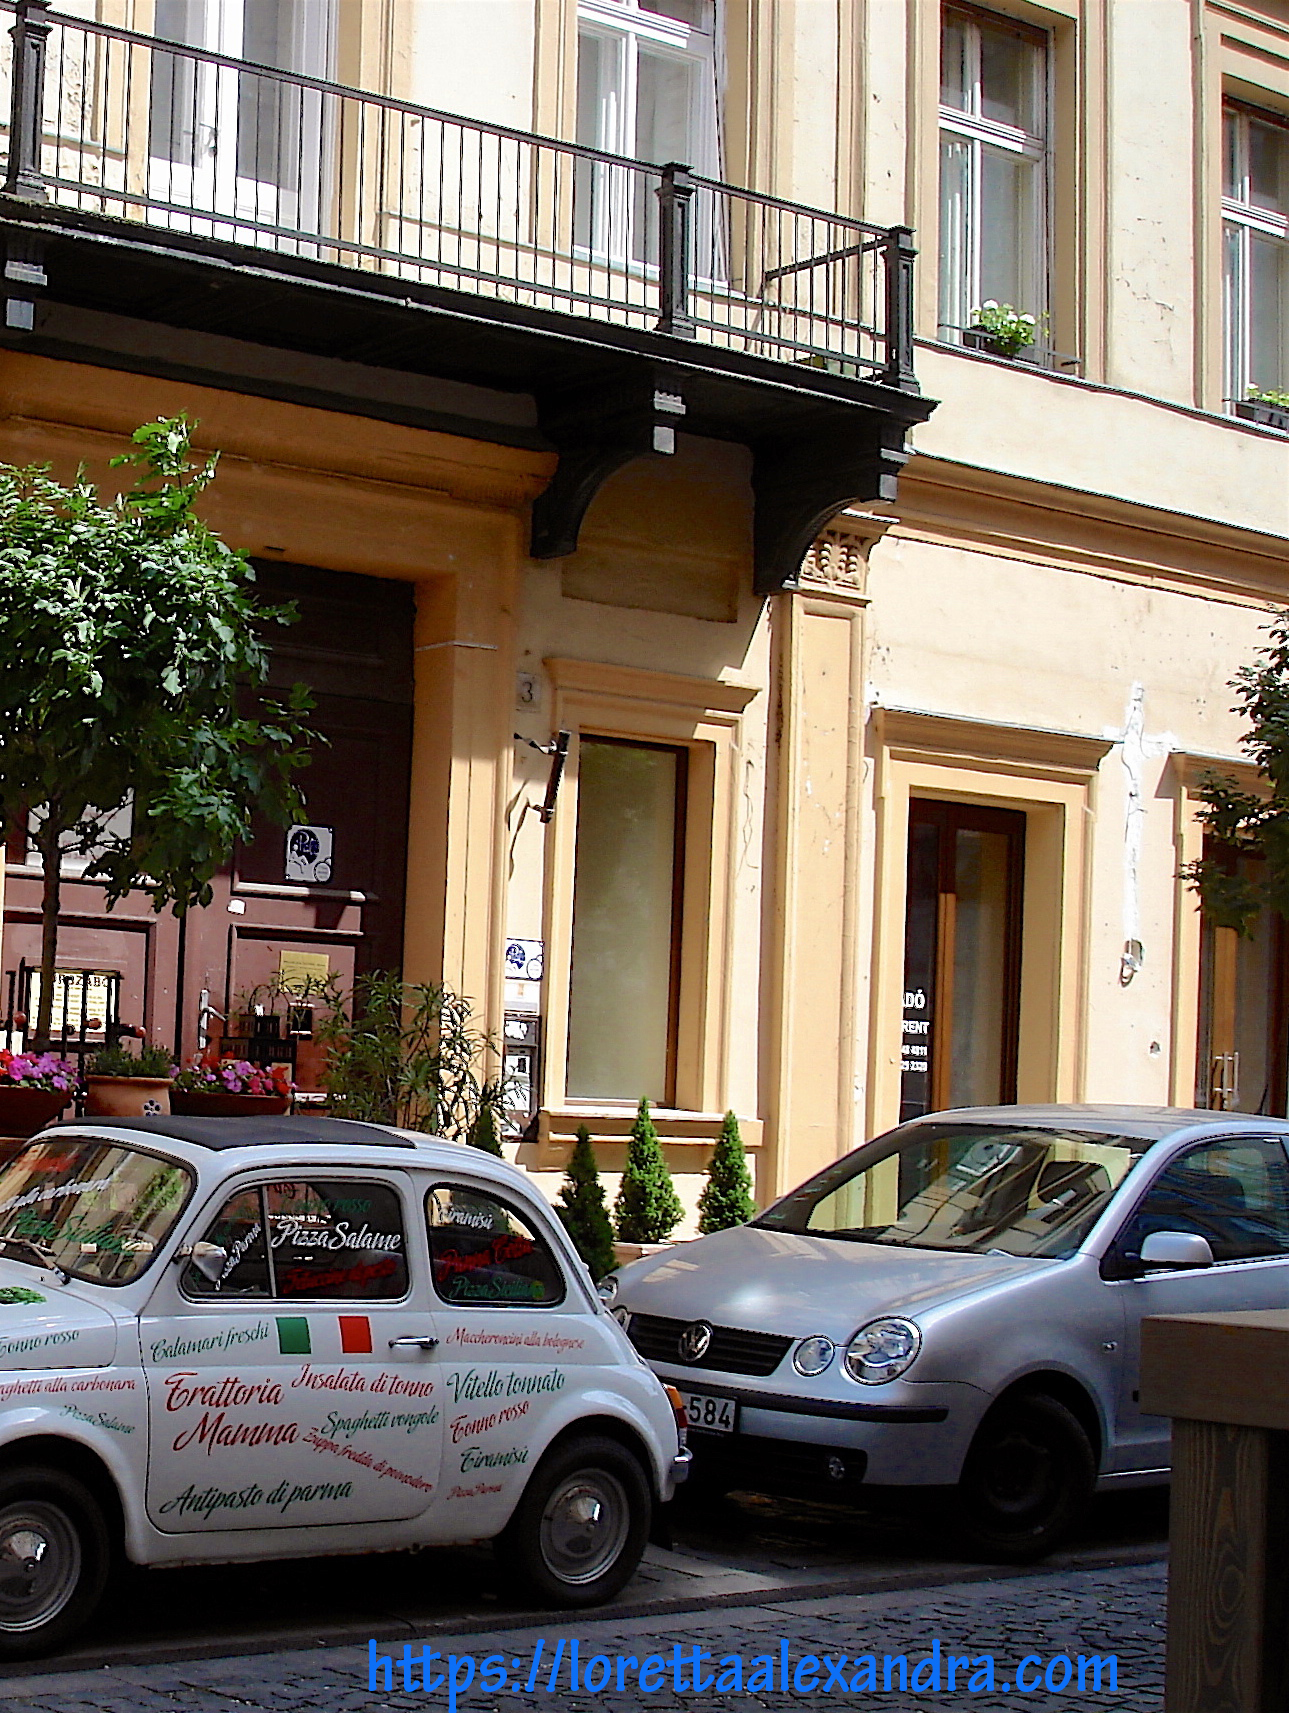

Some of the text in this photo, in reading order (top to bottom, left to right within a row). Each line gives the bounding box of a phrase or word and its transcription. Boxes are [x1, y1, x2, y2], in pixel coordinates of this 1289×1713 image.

[271, 1217, 401, 1250] Pizza Salame
[44, 1329, 79, 1346] rosso
[150, 1320, 269, 1363] Calamari freschi
[43, 1376, 67, 1393] alla
[71, 1375, 136, 1393] carbonara
[164, 1371, 285, 1412] Trattoria
[291, 1363, 435, 1397] Insalata di tonno
[446, 1367, 566, 1403] Vitello tonnato
[172, 1411, 300, 1456] Mamma
[320, 1404, 440, 1439] Spaghetti vongole
[450, 1400, 530, 1444] Tonno rosso
[159, 1480, 353, 1520] Antipasto di parma
